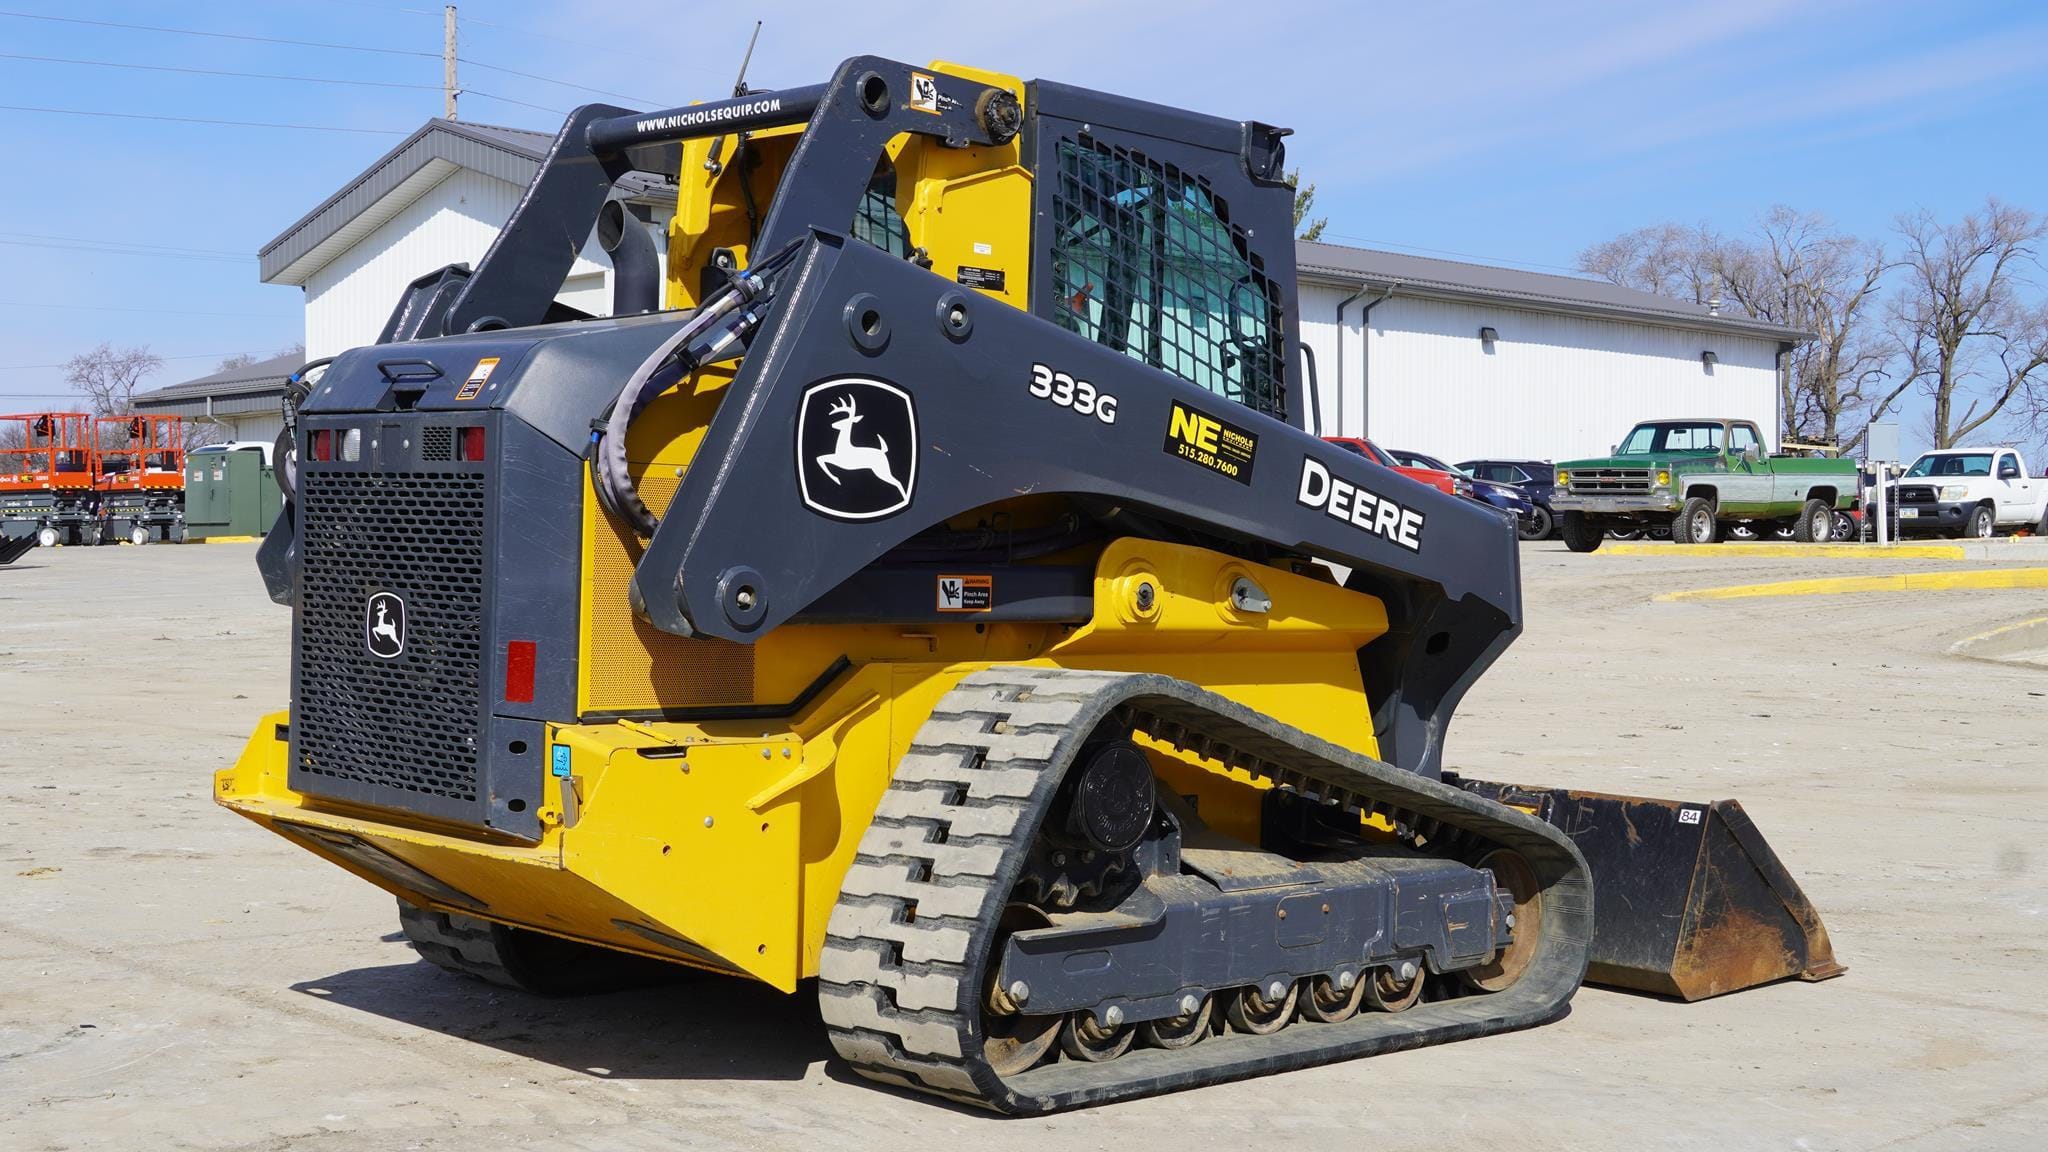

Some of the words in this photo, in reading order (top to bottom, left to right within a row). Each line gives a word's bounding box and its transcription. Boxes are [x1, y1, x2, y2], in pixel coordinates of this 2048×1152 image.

[636, 98, 781, 133] WWW.NICHOLSEQUIP.COM
[1028, 363, 1119, 424] 333G
[1169, 405, 1222, 455] NE
[1223, 429, 1254, 448] NICHOLS
[1177, 443, 1238, 477] 515.280.7600
[1297, 457, 1424, 550] DEERE
[1681, 810, 1698, 823] 84
